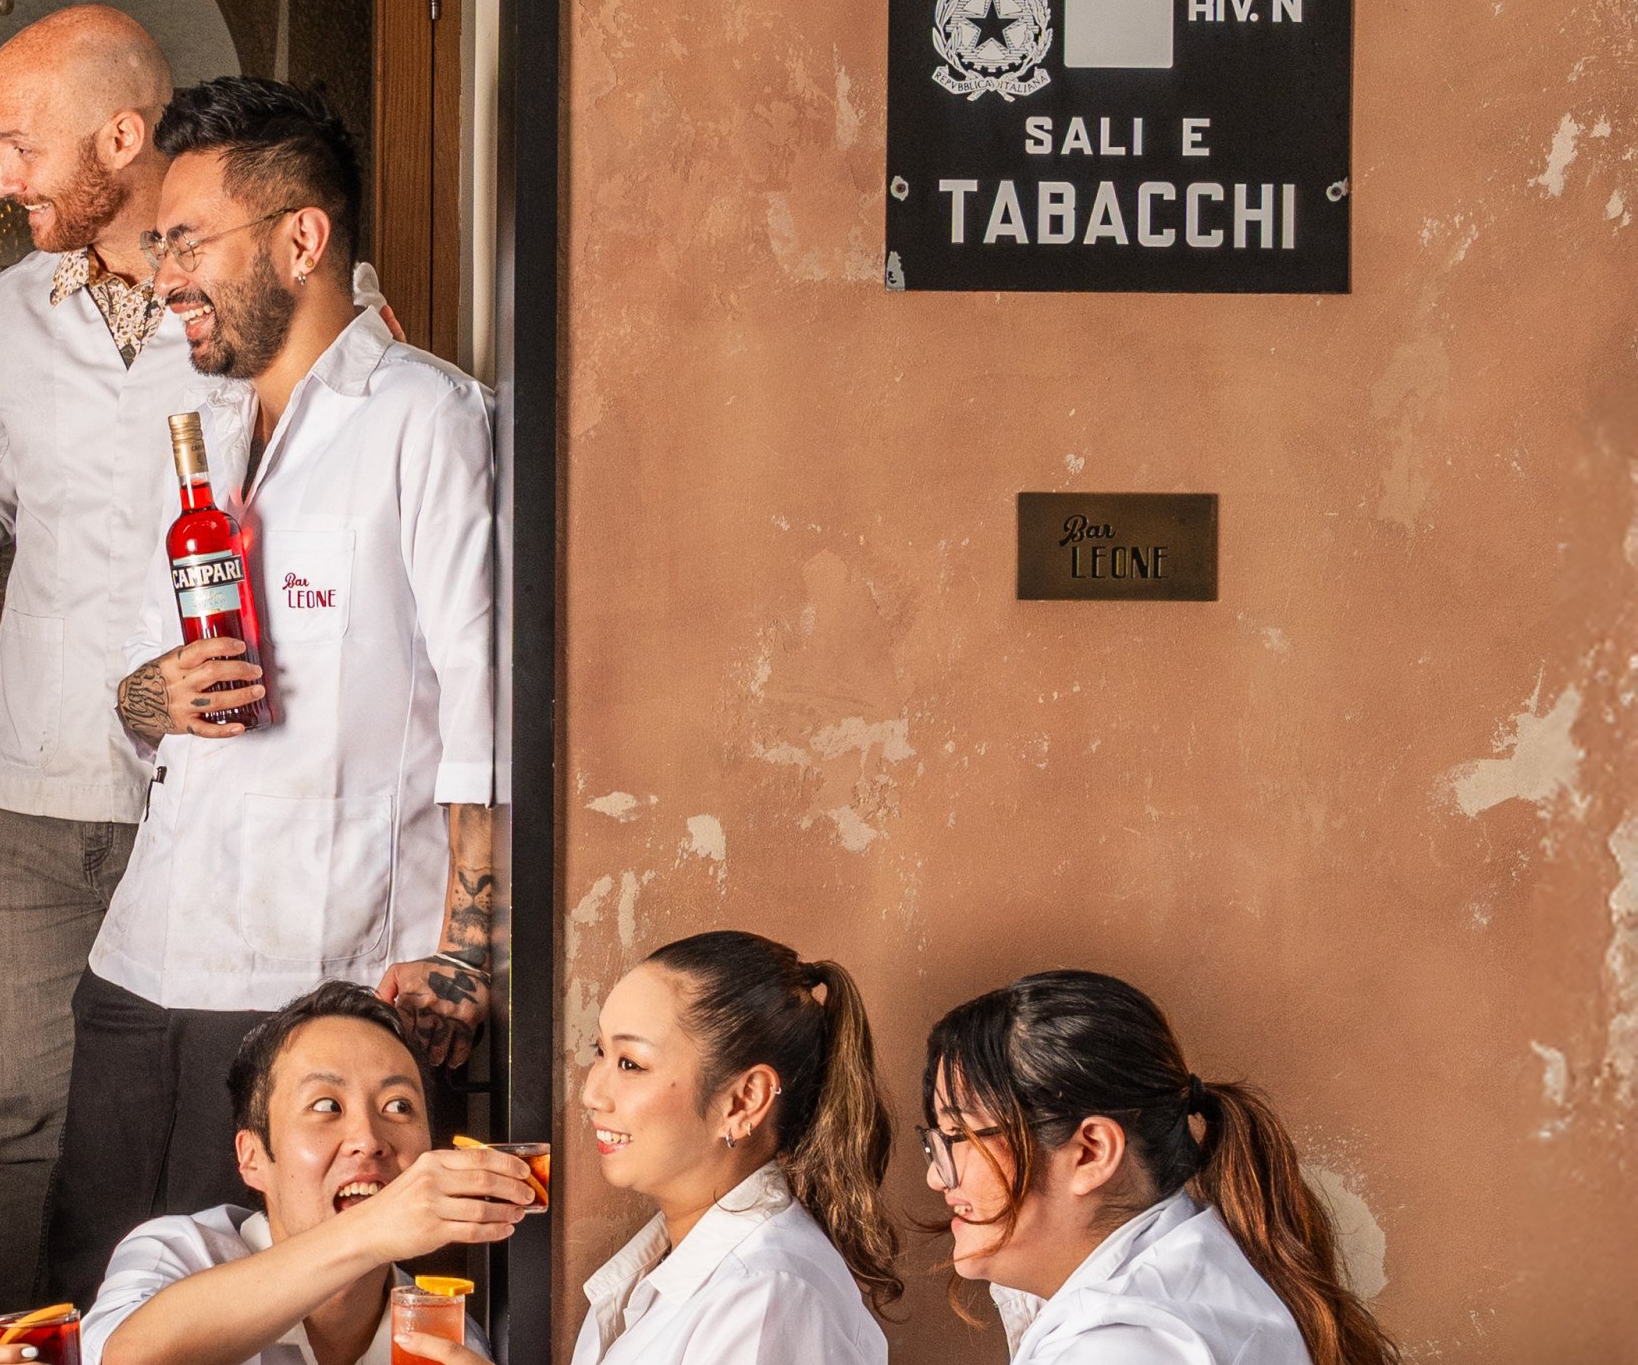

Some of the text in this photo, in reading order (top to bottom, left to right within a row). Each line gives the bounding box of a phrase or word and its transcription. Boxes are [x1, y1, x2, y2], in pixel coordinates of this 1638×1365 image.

[999, 74, 1049, 93] ITALIANA
[1024, 116, 1211, 157] SALI E
[938, 179, 1296, 250] TABACCHI
[1059, 514, 1117, 548] Bar
[172, 559, 242, 590] CAMPARI
[1071, 546, 1170, 579] LEONE
[282, 572, 310, 590] Bar
[288, 589, 336, 609] LEONE
